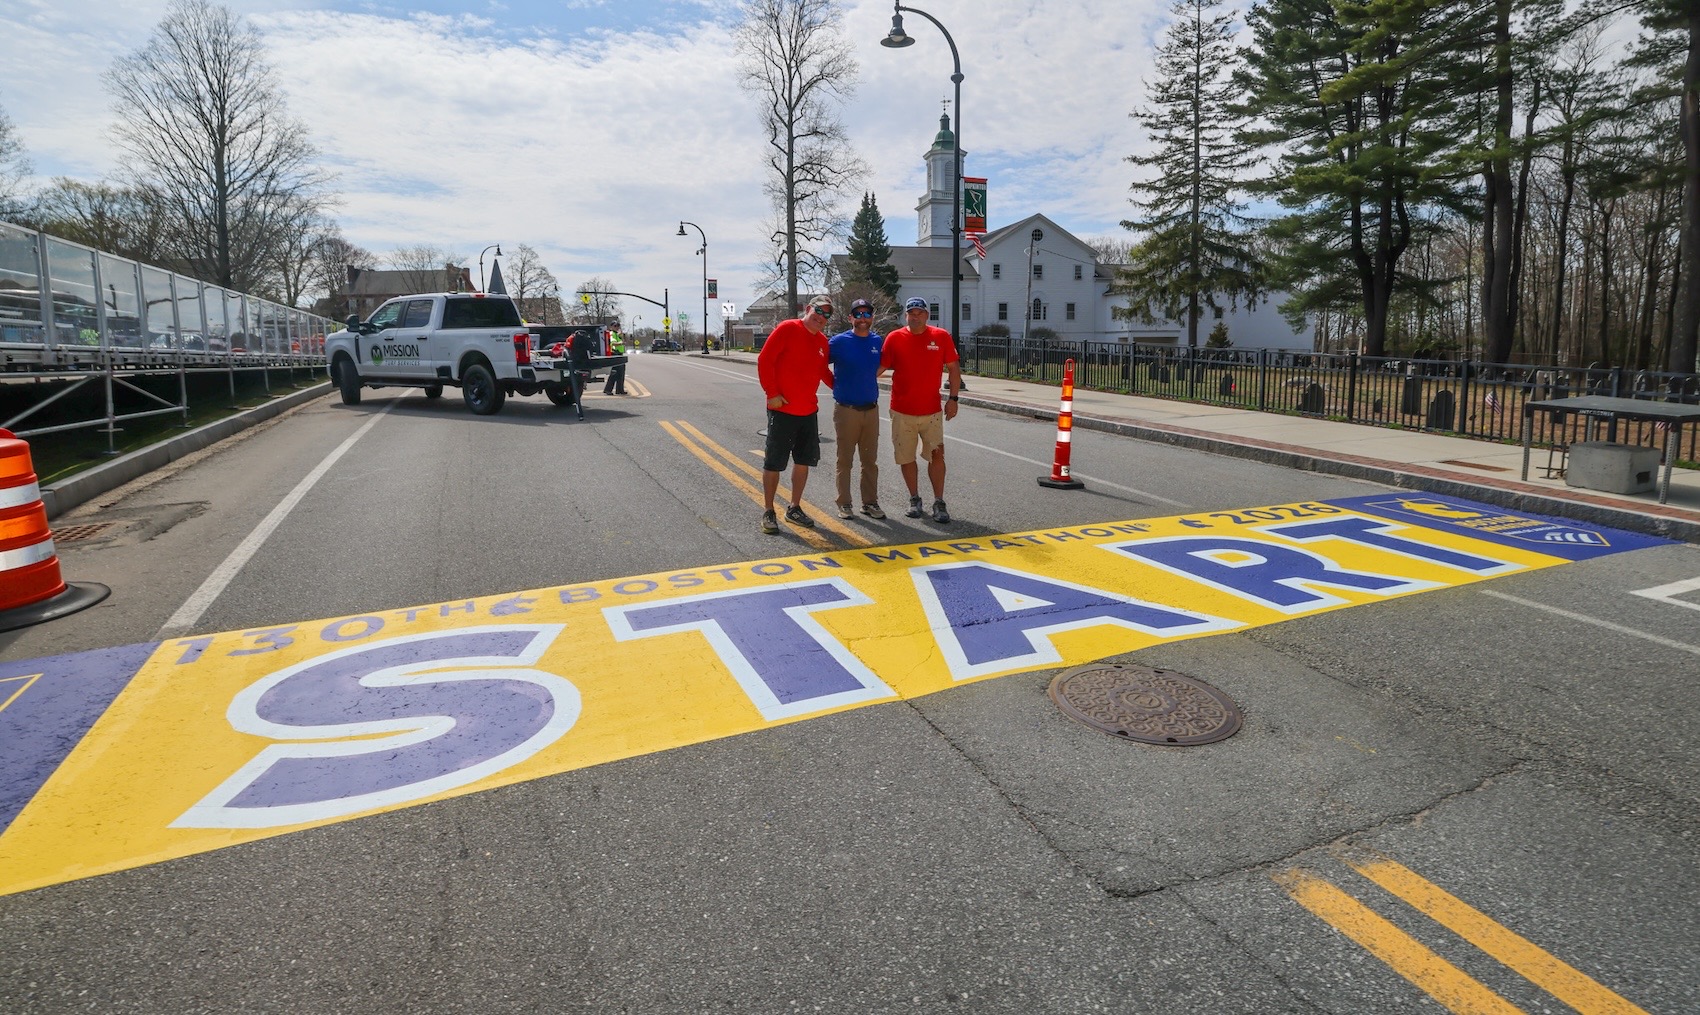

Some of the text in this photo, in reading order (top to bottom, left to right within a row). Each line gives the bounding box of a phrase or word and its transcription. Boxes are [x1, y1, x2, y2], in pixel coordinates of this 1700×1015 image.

[383, 344, 420, 357] MISSION
[176, 600, 475, 665] 130TH
[559, 557, 843, 604] BOSTON
[1215, 502, 1341, 526] 2026
[167, 514, 1531, 828] START
